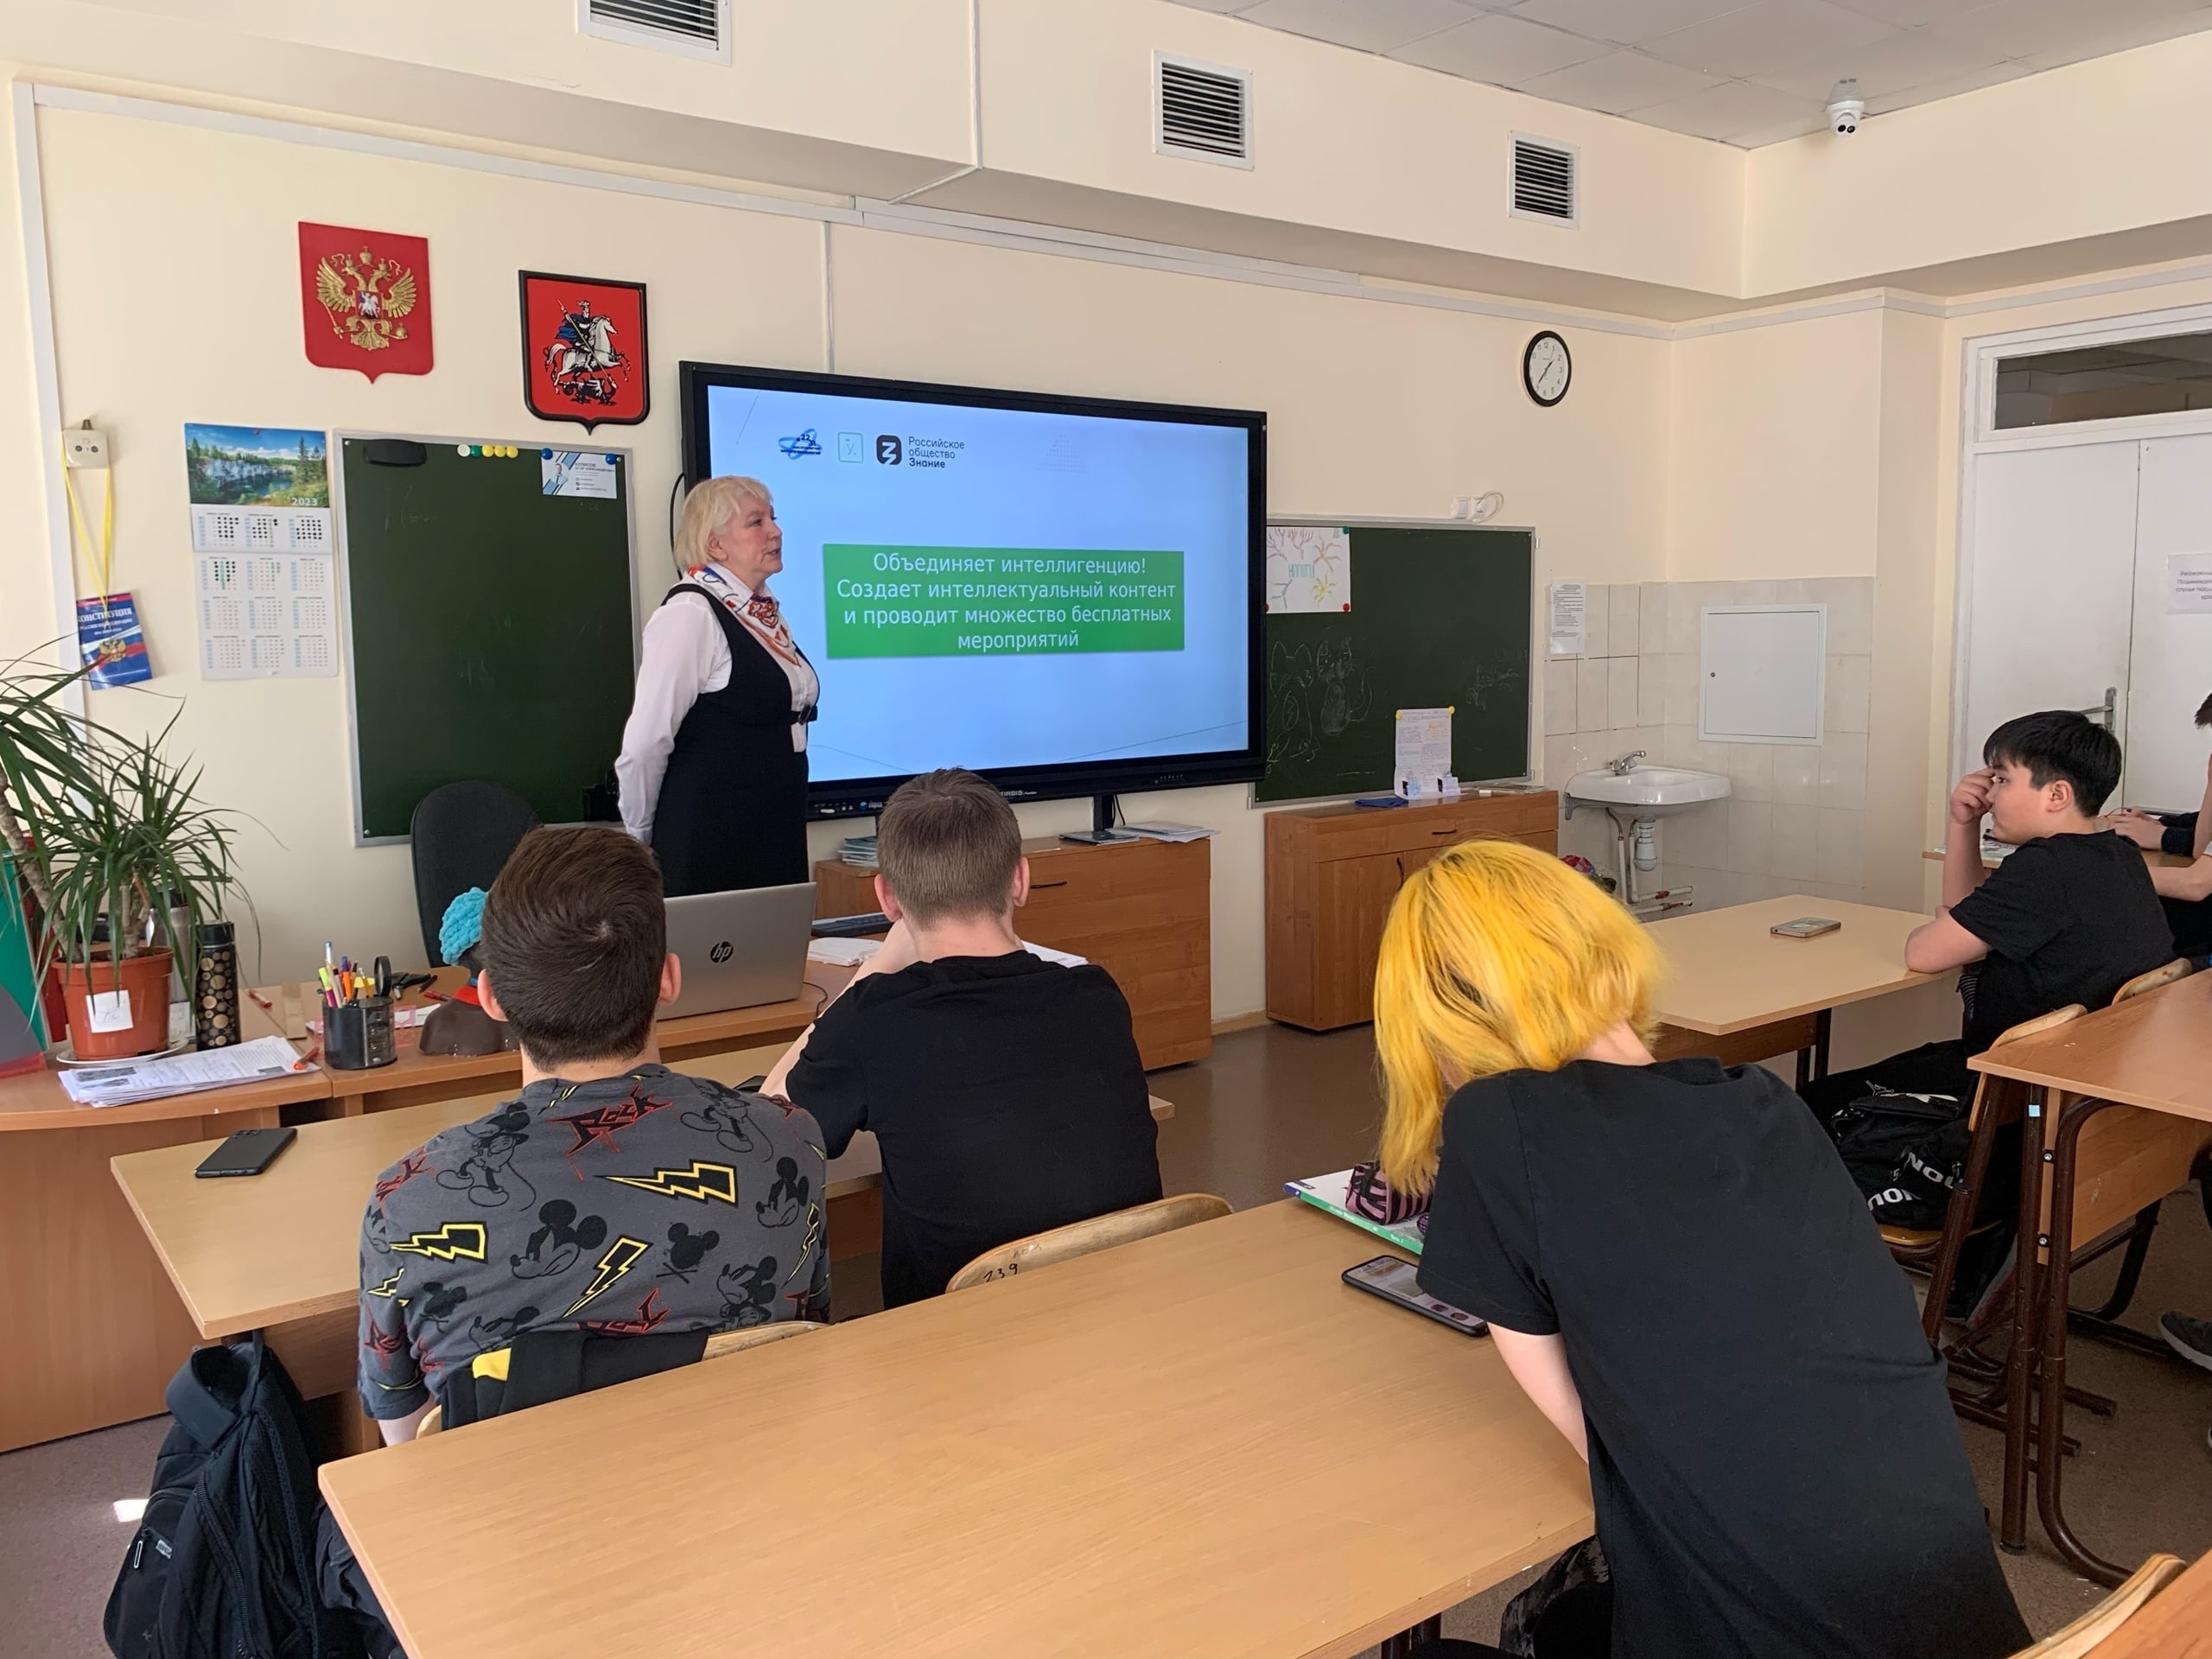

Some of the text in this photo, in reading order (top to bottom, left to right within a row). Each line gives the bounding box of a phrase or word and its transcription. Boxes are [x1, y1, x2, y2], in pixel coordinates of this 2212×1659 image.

[908, 435, 965, 449] Российское
[908, 448, 956, 460] общество
[908, 457, 946, 468] Знание
[291, 497, 319, 506] 2023
[873, 552, 1147, 576] Объединяет интеллигенцию!
[836, 579, 1176, 602] Создает интеллектуальный контент
[844, 605, 1173, 629] и проводит множество бесплатных
[957, 629, 1079, 652] мероприятий
[710, 941, 734, 963] hp
